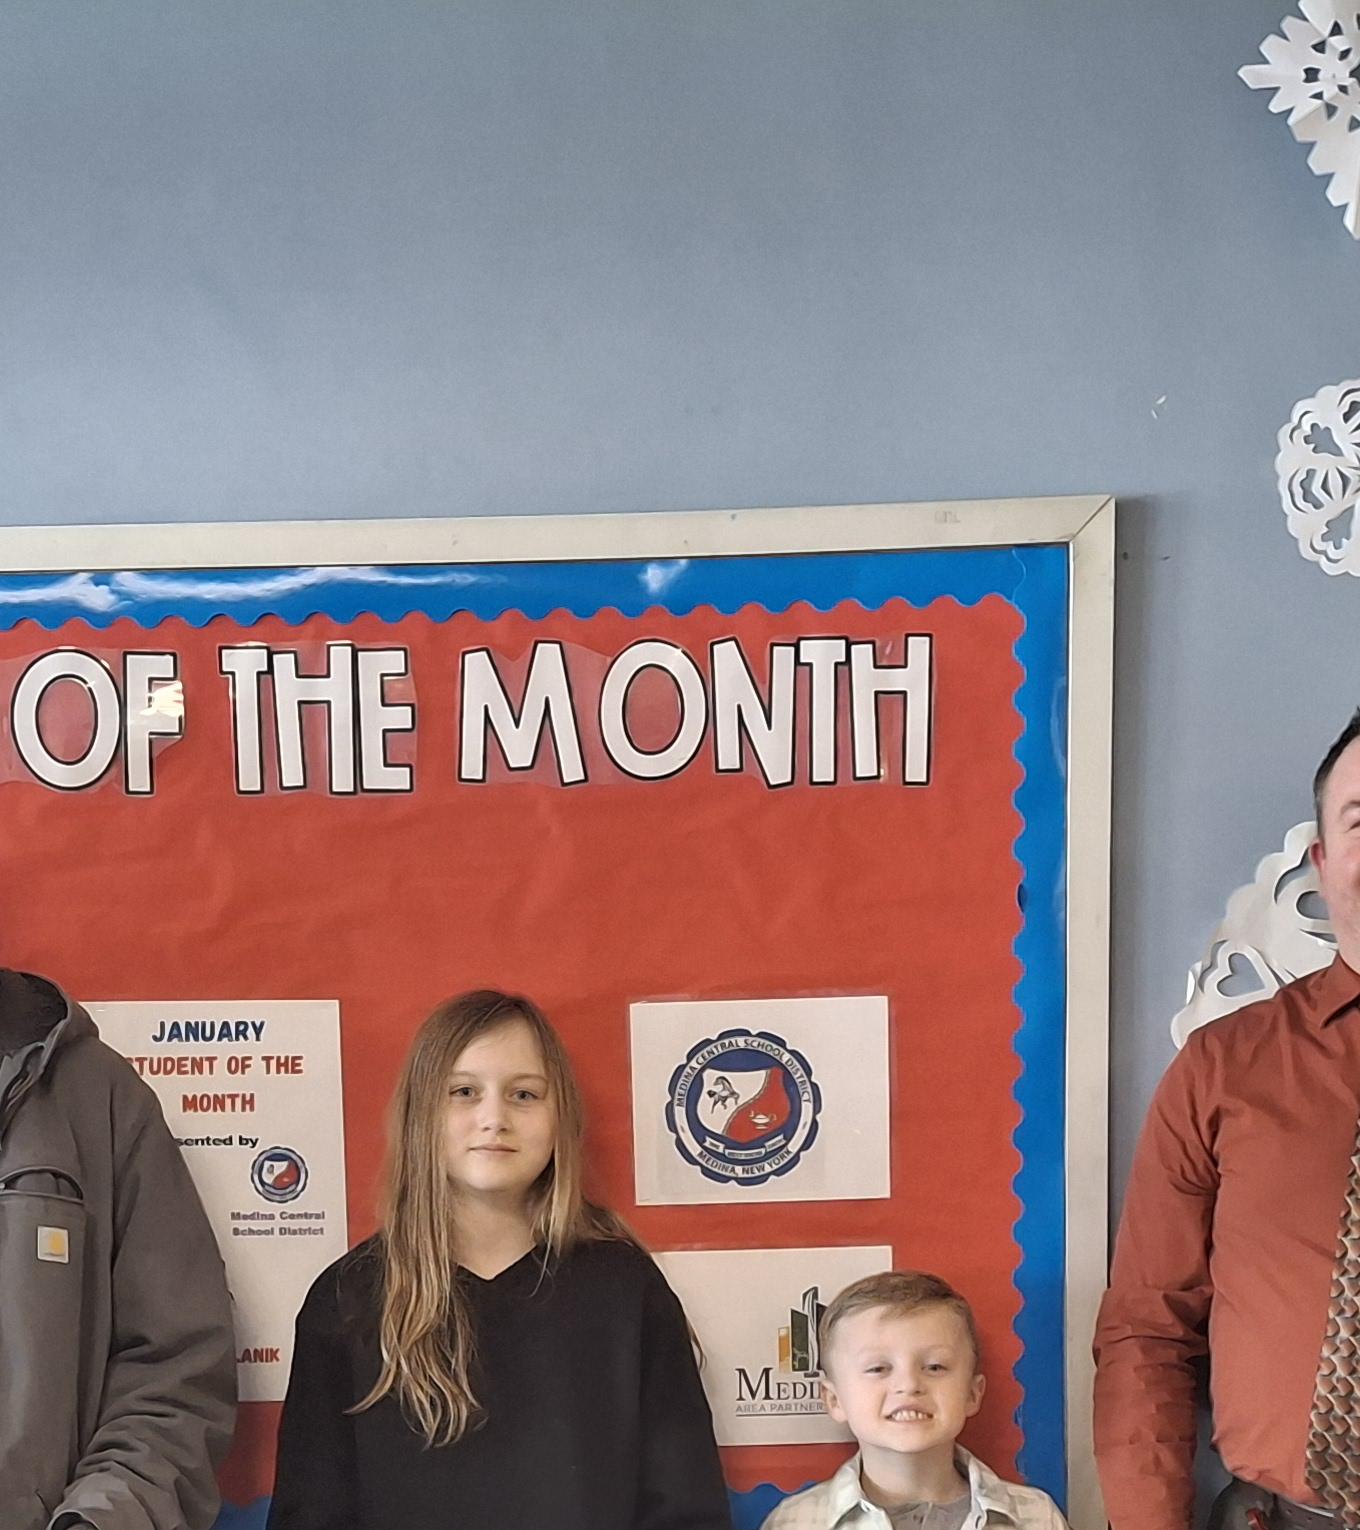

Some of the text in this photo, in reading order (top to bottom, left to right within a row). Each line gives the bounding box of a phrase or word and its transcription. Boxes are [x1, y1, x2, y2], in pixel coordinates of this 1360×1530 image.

[10, 645, 184, 795] OF
[219, 640, 415, 795] THE
[456, 632, 935, 789] MONTH
[151, 1020, 266, 1043] JANUARY
[226, 1056, 253, 1075] OF
[261, 1055, 304, 1075] THE
[676, 1039, 812, 1107] MEDINA CENTRAL SCHOOL DISTRICT
[182, 1093, 255, 1113] MONTH
[239, 1135, 259, 1148] by
[697, 1147, 793, 1177] MEDINA, NEW YORK
[231, 1211, 325, 1221] Medina Central
[232, 1226, 324, 1236] School District
[735, 1367, 822, 1401] MEDI
[736, 1403, 766, 1412] AREA
